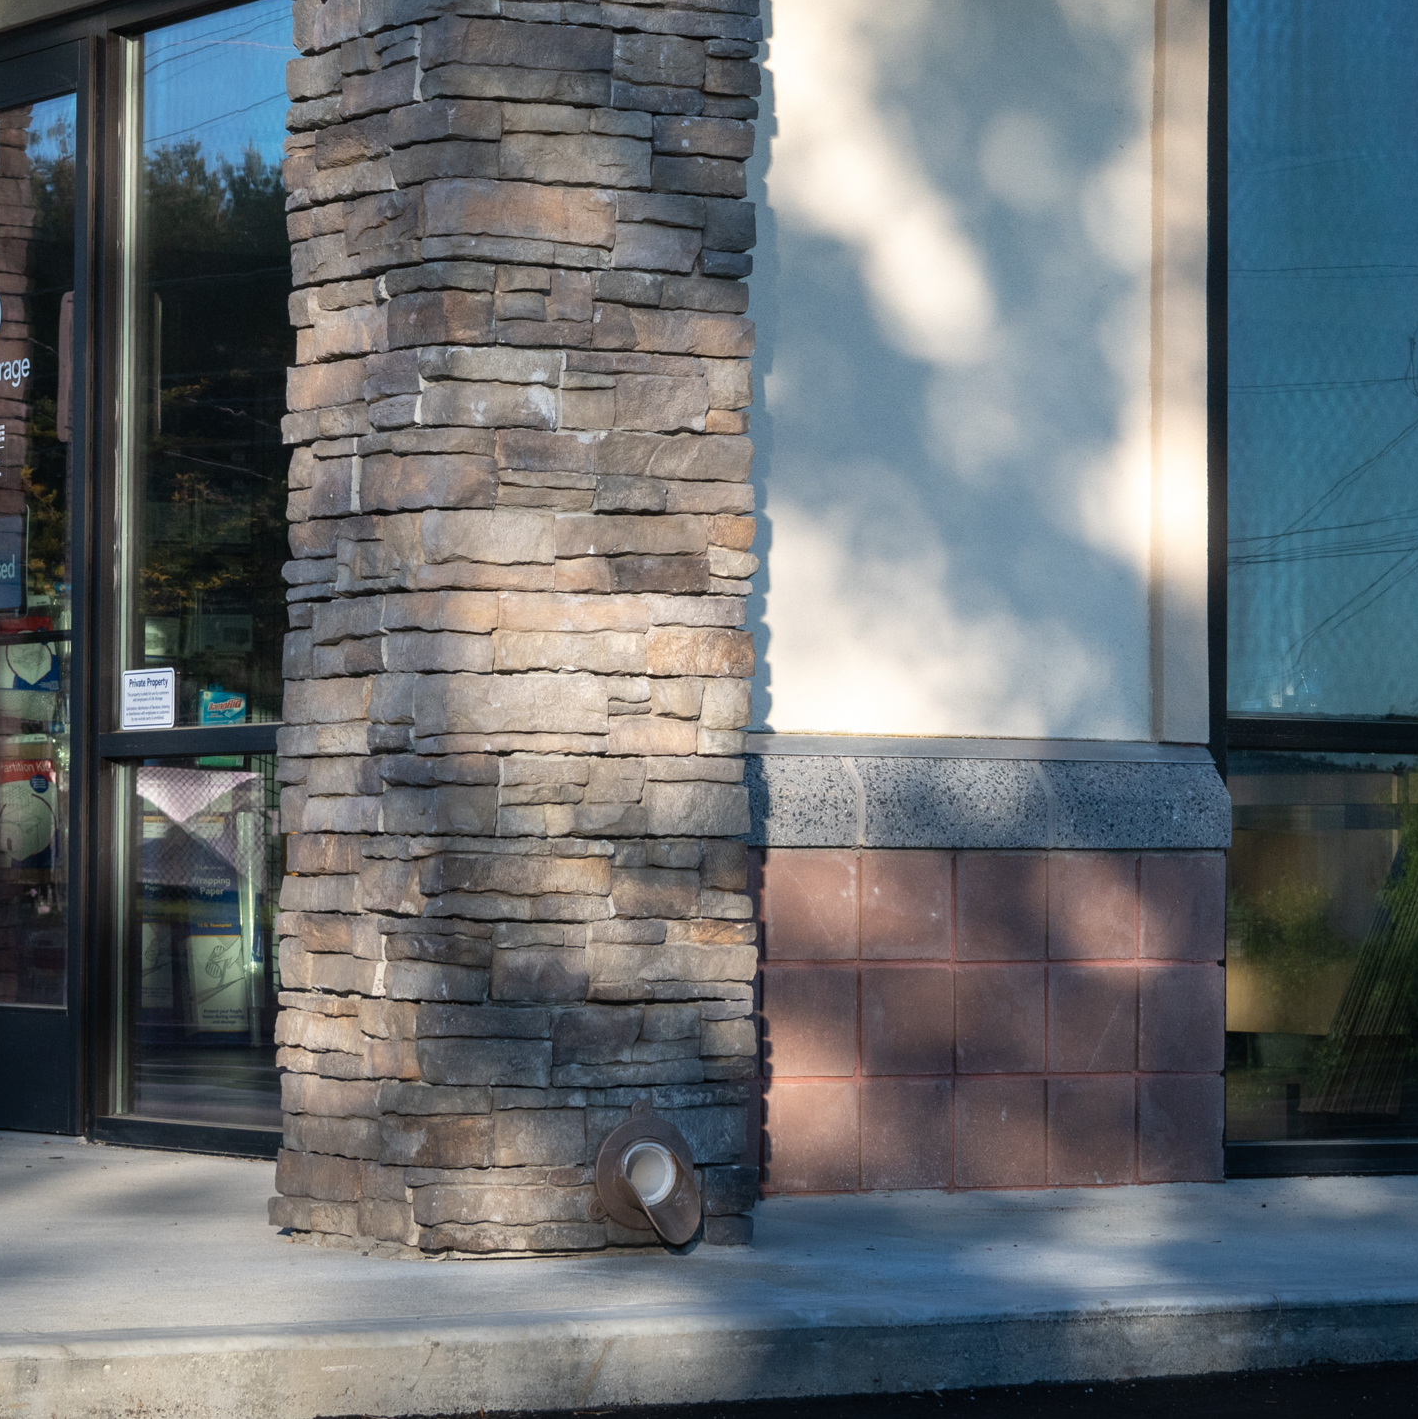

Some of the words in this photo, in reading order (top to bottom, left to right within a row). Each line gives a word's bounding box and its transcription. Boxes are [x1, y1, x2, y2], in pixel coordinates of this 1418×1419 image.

[129, 678, 146, 688] Private
[147, 677, 169, 689] Property
[191, 876, 231, 887] Wrapping
[200, 887, 224, 897] Paper
